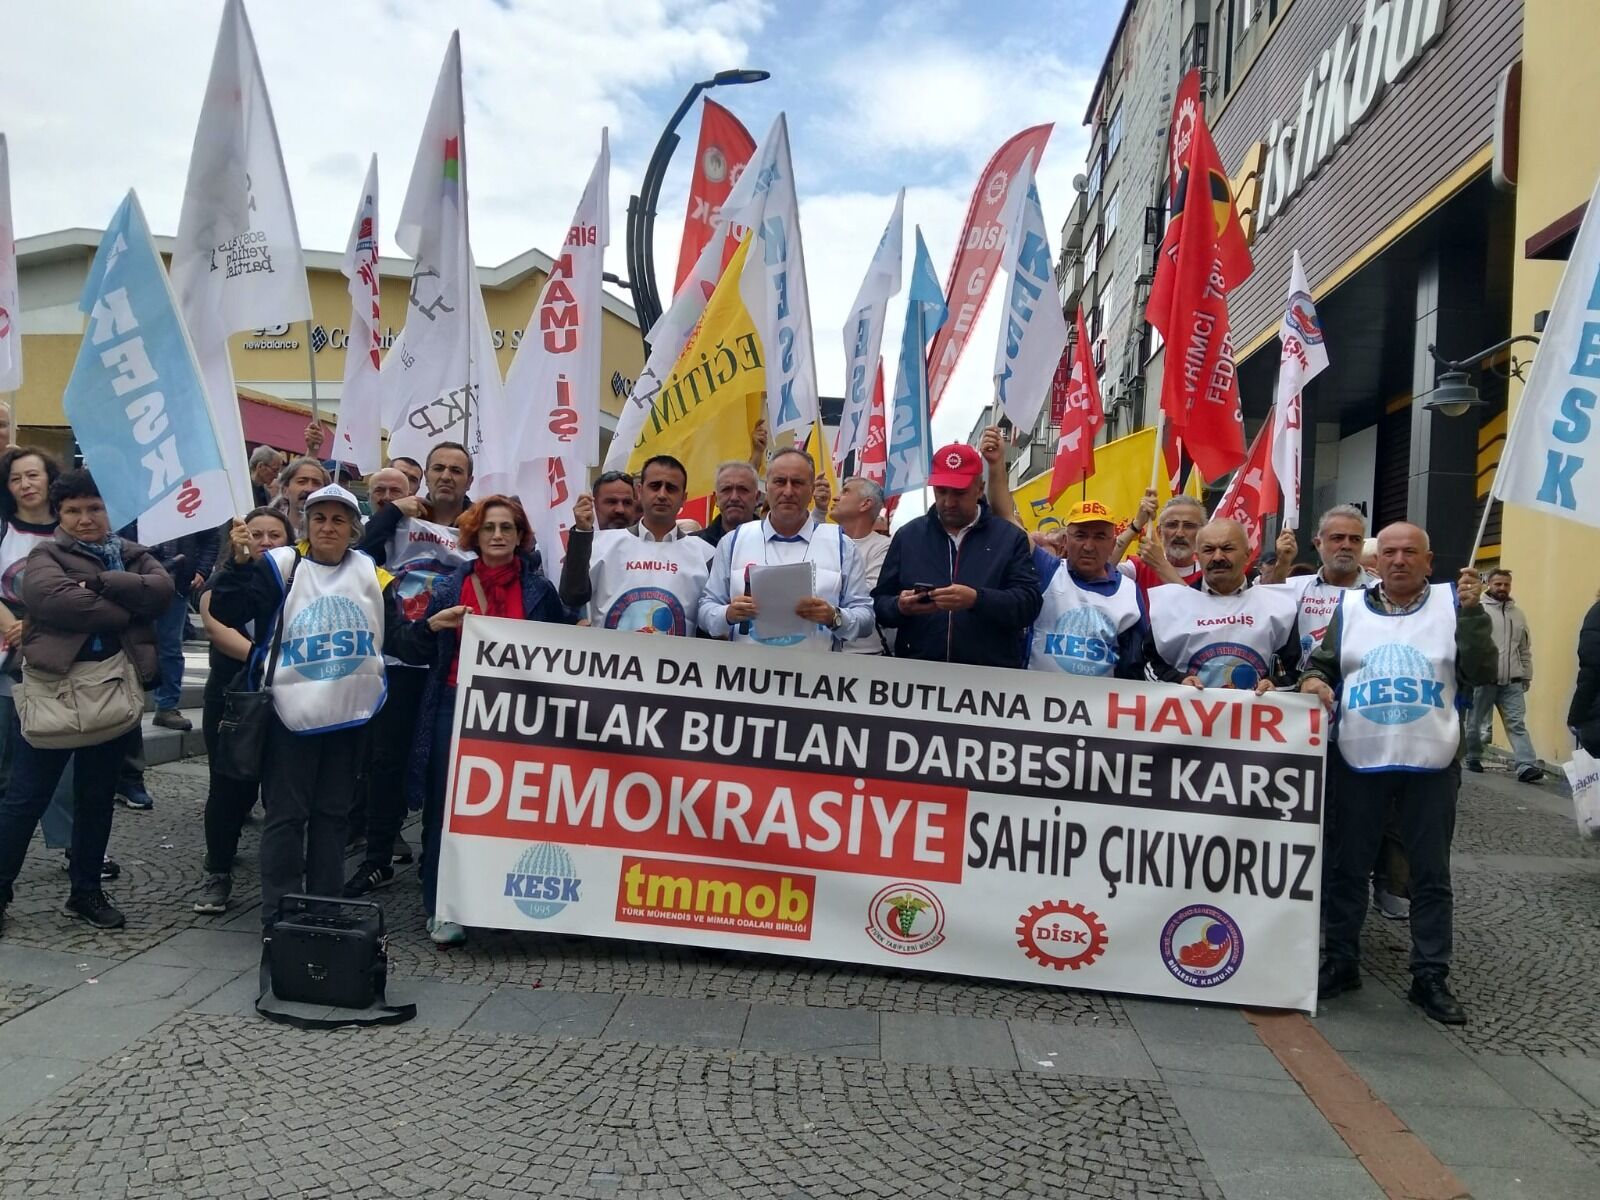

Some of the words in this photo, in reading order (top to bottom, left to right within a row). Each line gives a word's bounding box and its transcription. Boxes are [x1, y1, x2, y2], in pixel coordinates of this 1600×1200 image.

[1257, 0, 1446, 233] istikba
[1536, 262, 1600, 511] ESK
[1082, 500, 1108, 516] BES
[625, 560, 679, 574] KAMU-İŞ
[1197, 614, 1254, 627] KAMU-İŞ
[281, 630, 377, 667] KESK
[320, 664, 347, 679] 1995
[1071, 662, 1096, 676] 1995
[476, 640, 644, 682] KAYYUMA
[656, 659, 703, 688] DA
[716, 665, 858, 704] MUTLAK
[870, 679, 1031, 721] BUTLANA
[1043, 697, 1092, 726] DA
[1107, 692, 1288, 744] HAYIR
[1308, 708, 1321, 747] !
[1347, 677, 1447, 710] KESK
[1381, 710, 1409, 720] 1995
[465, 689, 667, 748] MUTLAK
[680, 711, 870, 769] BUTLAN
[885, 730, 1153, 796] DARBESİNE
[1170, 758, 1316, 821] KARŞI
[453, 754, 948, 864] DEMOKRASİYE
[967, 806, 1088, 878] SAHİP
[1099, 825, 1317, 901] ÇIKIYORUZ
[503, 872, 582, 902] KESK
[624, 863, 808, 922] tmmob
[528, 904, 551, 916] 1995
[622, 907, 645, 917] TÜRK
[647, 910, 691, 922] MÜHENDİS
[693, 914, 705, 923] VE
[706, 915, 735, 926] MİMAR
[737, 919, 773, 930] ODALARI
[775, 921, 807, 934] BİRLİĞİ
[1035, 922, 1088, 945] DİSK
